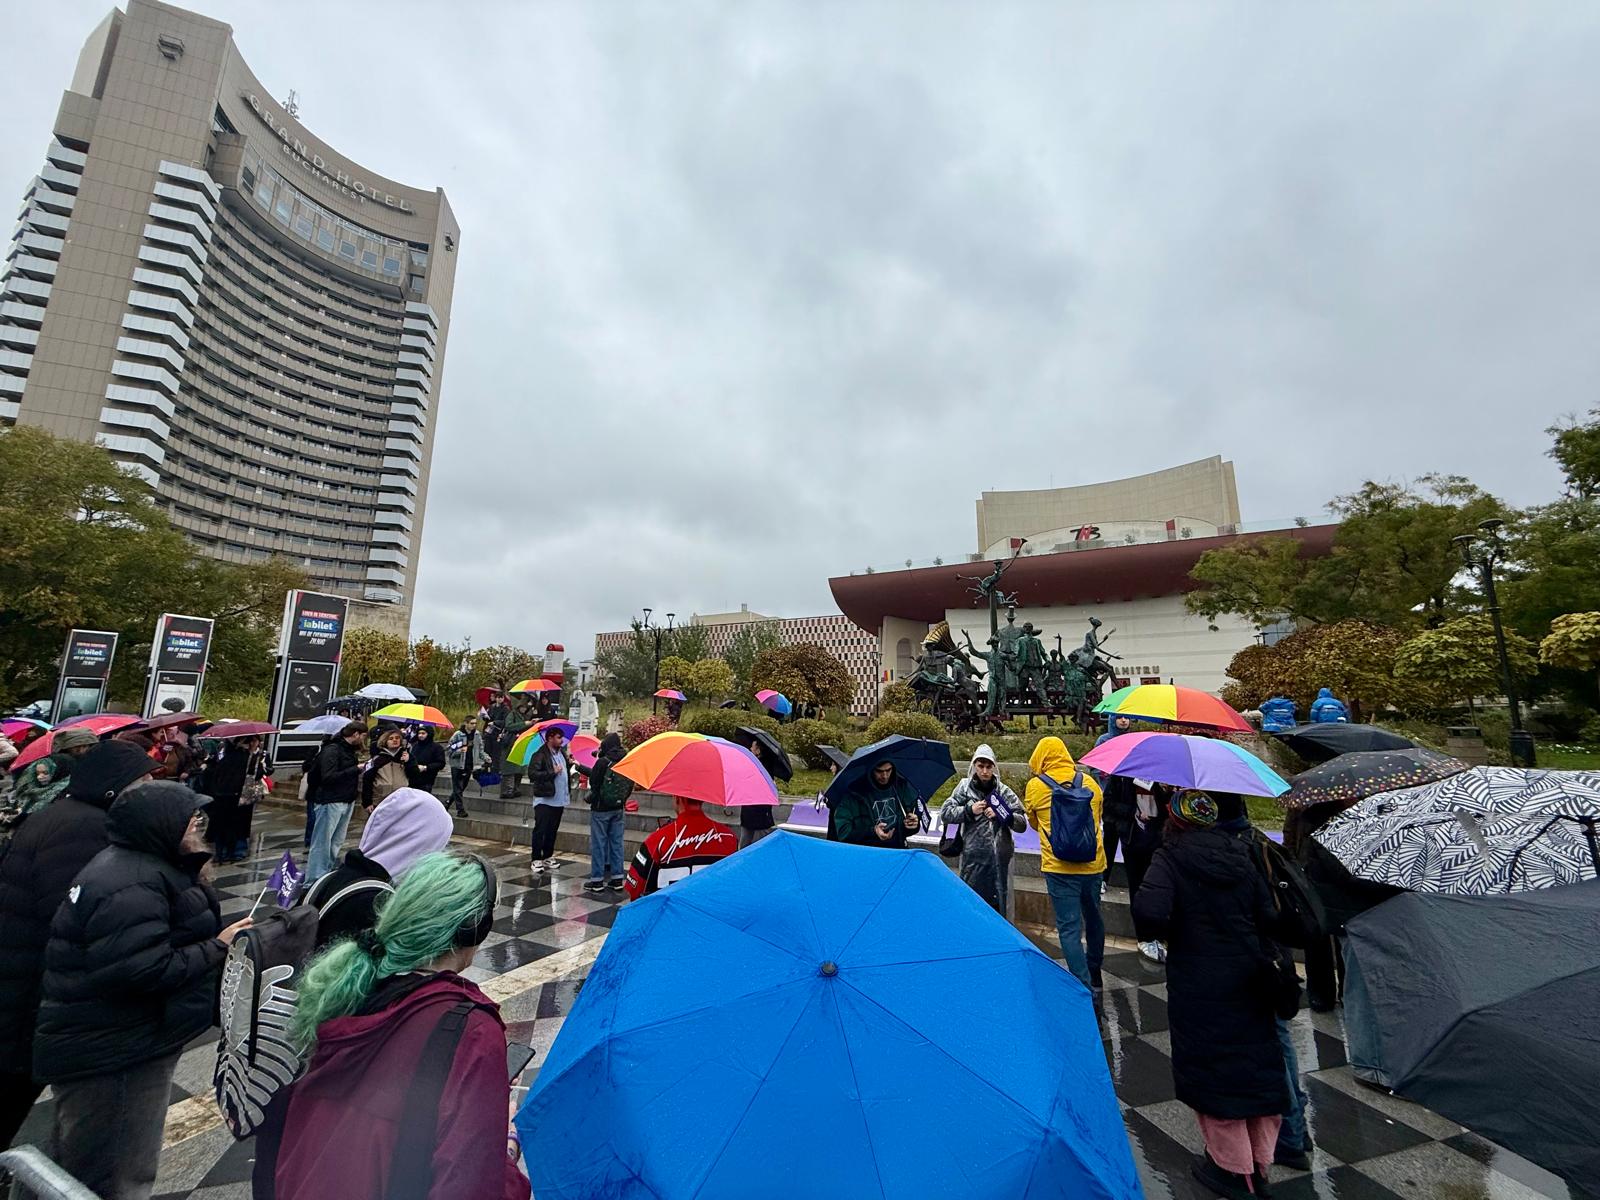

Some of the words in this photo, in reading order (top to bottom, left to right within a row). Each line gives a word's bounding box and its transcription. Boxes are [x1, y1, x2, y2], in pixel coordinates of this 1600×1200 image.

[250, 94, 326, 169] GRAND
[337, 170, 410, 211] HOTEL
[283, 144, 365, 204] BUCHAREST
[172, 638, 198, 647] iabilet
[303, 620, 333, 630] iabilet
